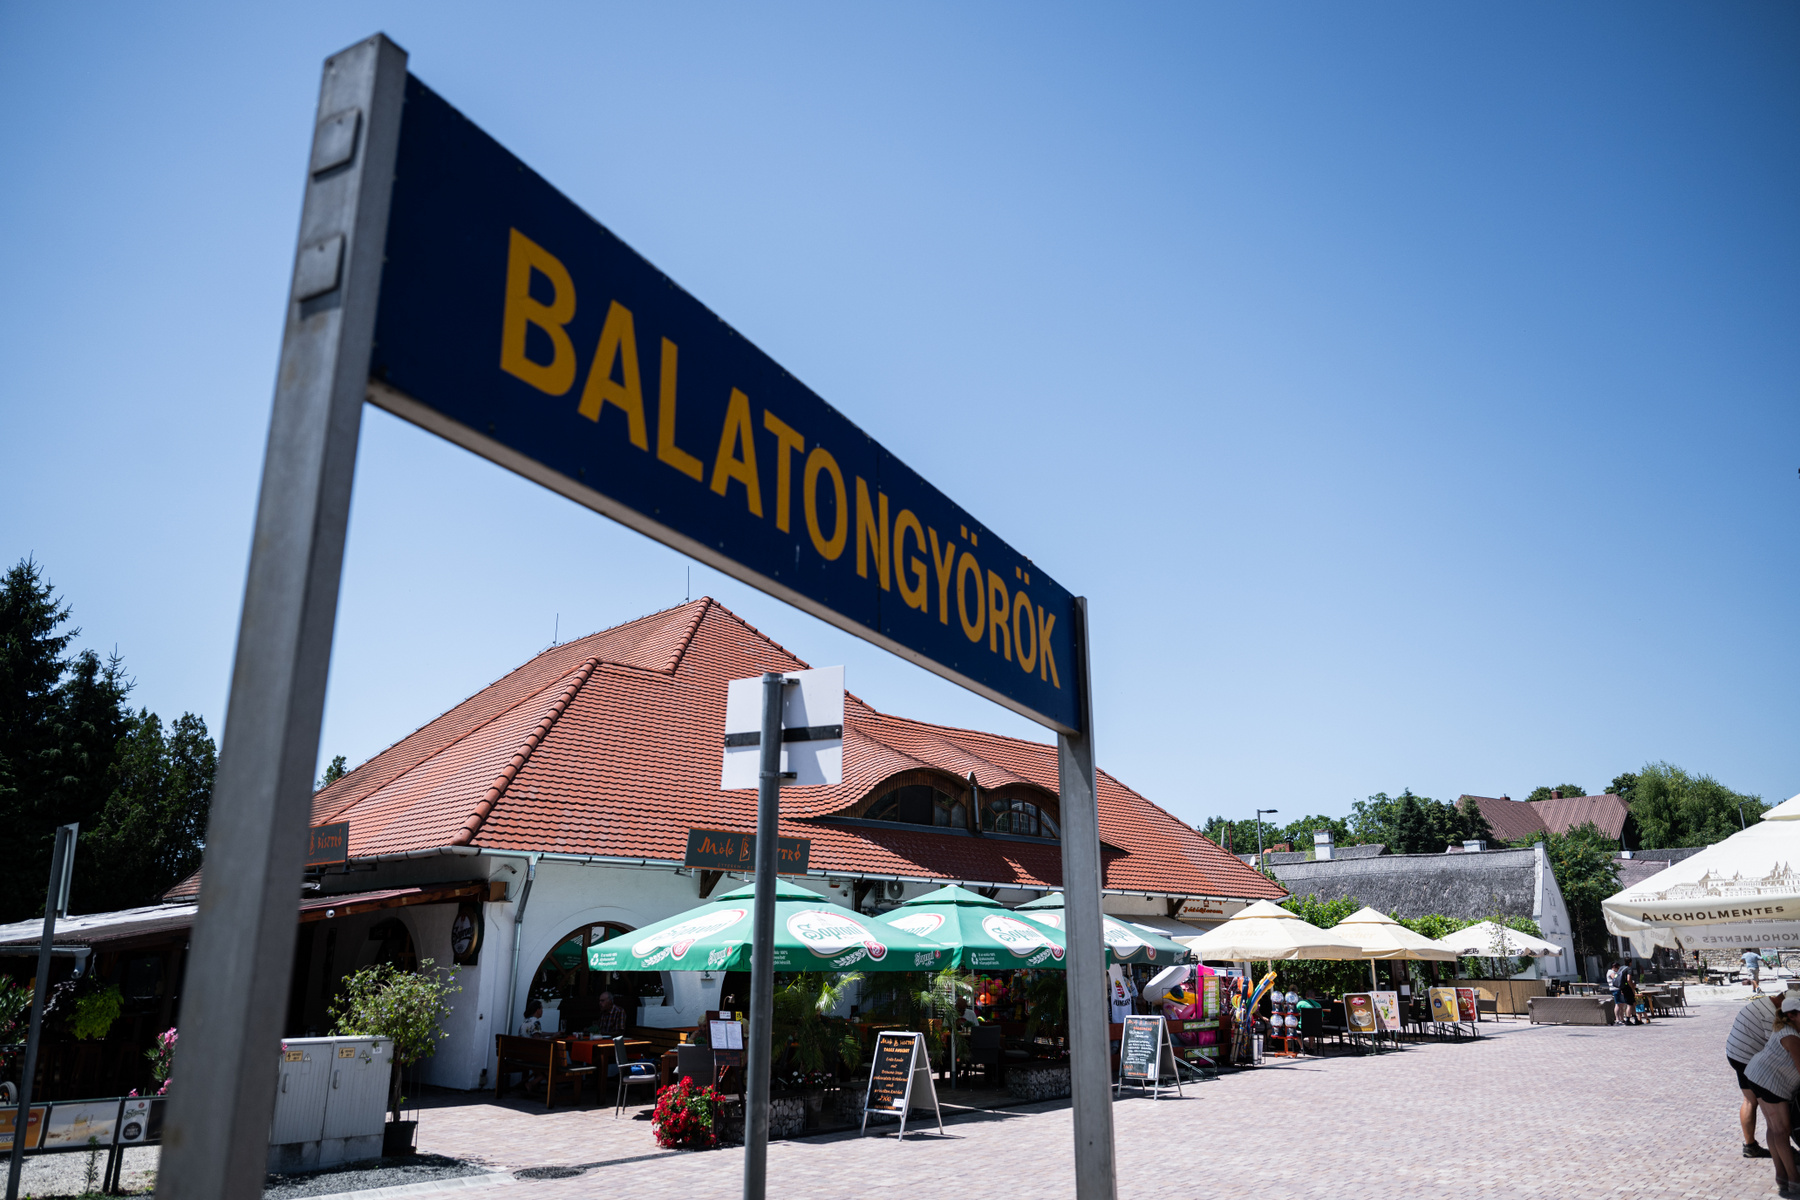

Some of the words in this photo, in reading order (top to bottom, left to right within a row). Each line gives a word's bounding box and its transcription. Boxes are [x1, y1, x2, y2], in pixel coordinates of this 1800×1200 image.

[501, 226, 1060, 689] BALATONGYÖRÖK
[1641, 905, 1785, 922] ALKOHOLMENTES
[797, 923, 865, 941] Soproni
